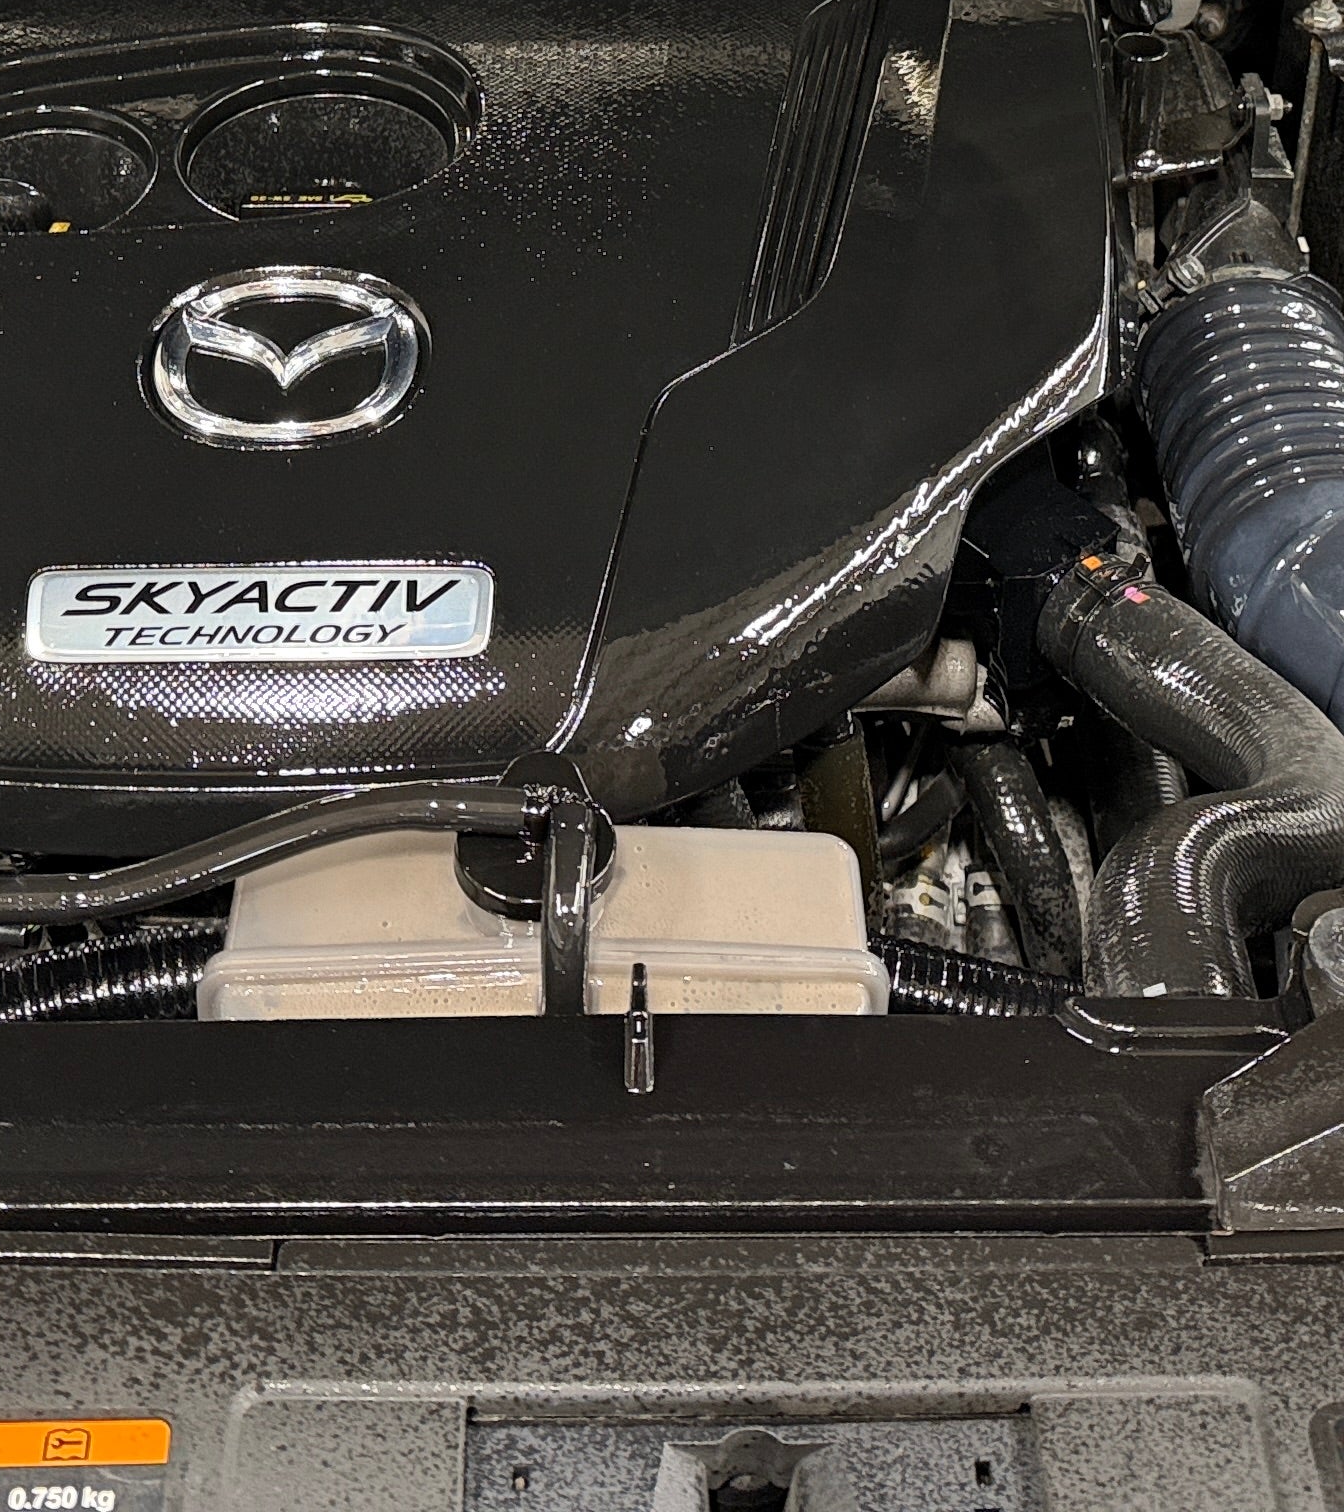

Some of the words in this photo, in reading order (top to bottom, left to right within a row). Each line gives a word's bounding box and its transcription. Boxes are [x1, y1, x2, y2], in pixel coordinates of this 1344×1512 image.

[62, 579, 461, 616] SKYACTIV
[103, 623, 408, 647] TECHNOLOGY
[7, 1486, 78, 1511] 0.750
[81, 1485, 116, 1512] kg
